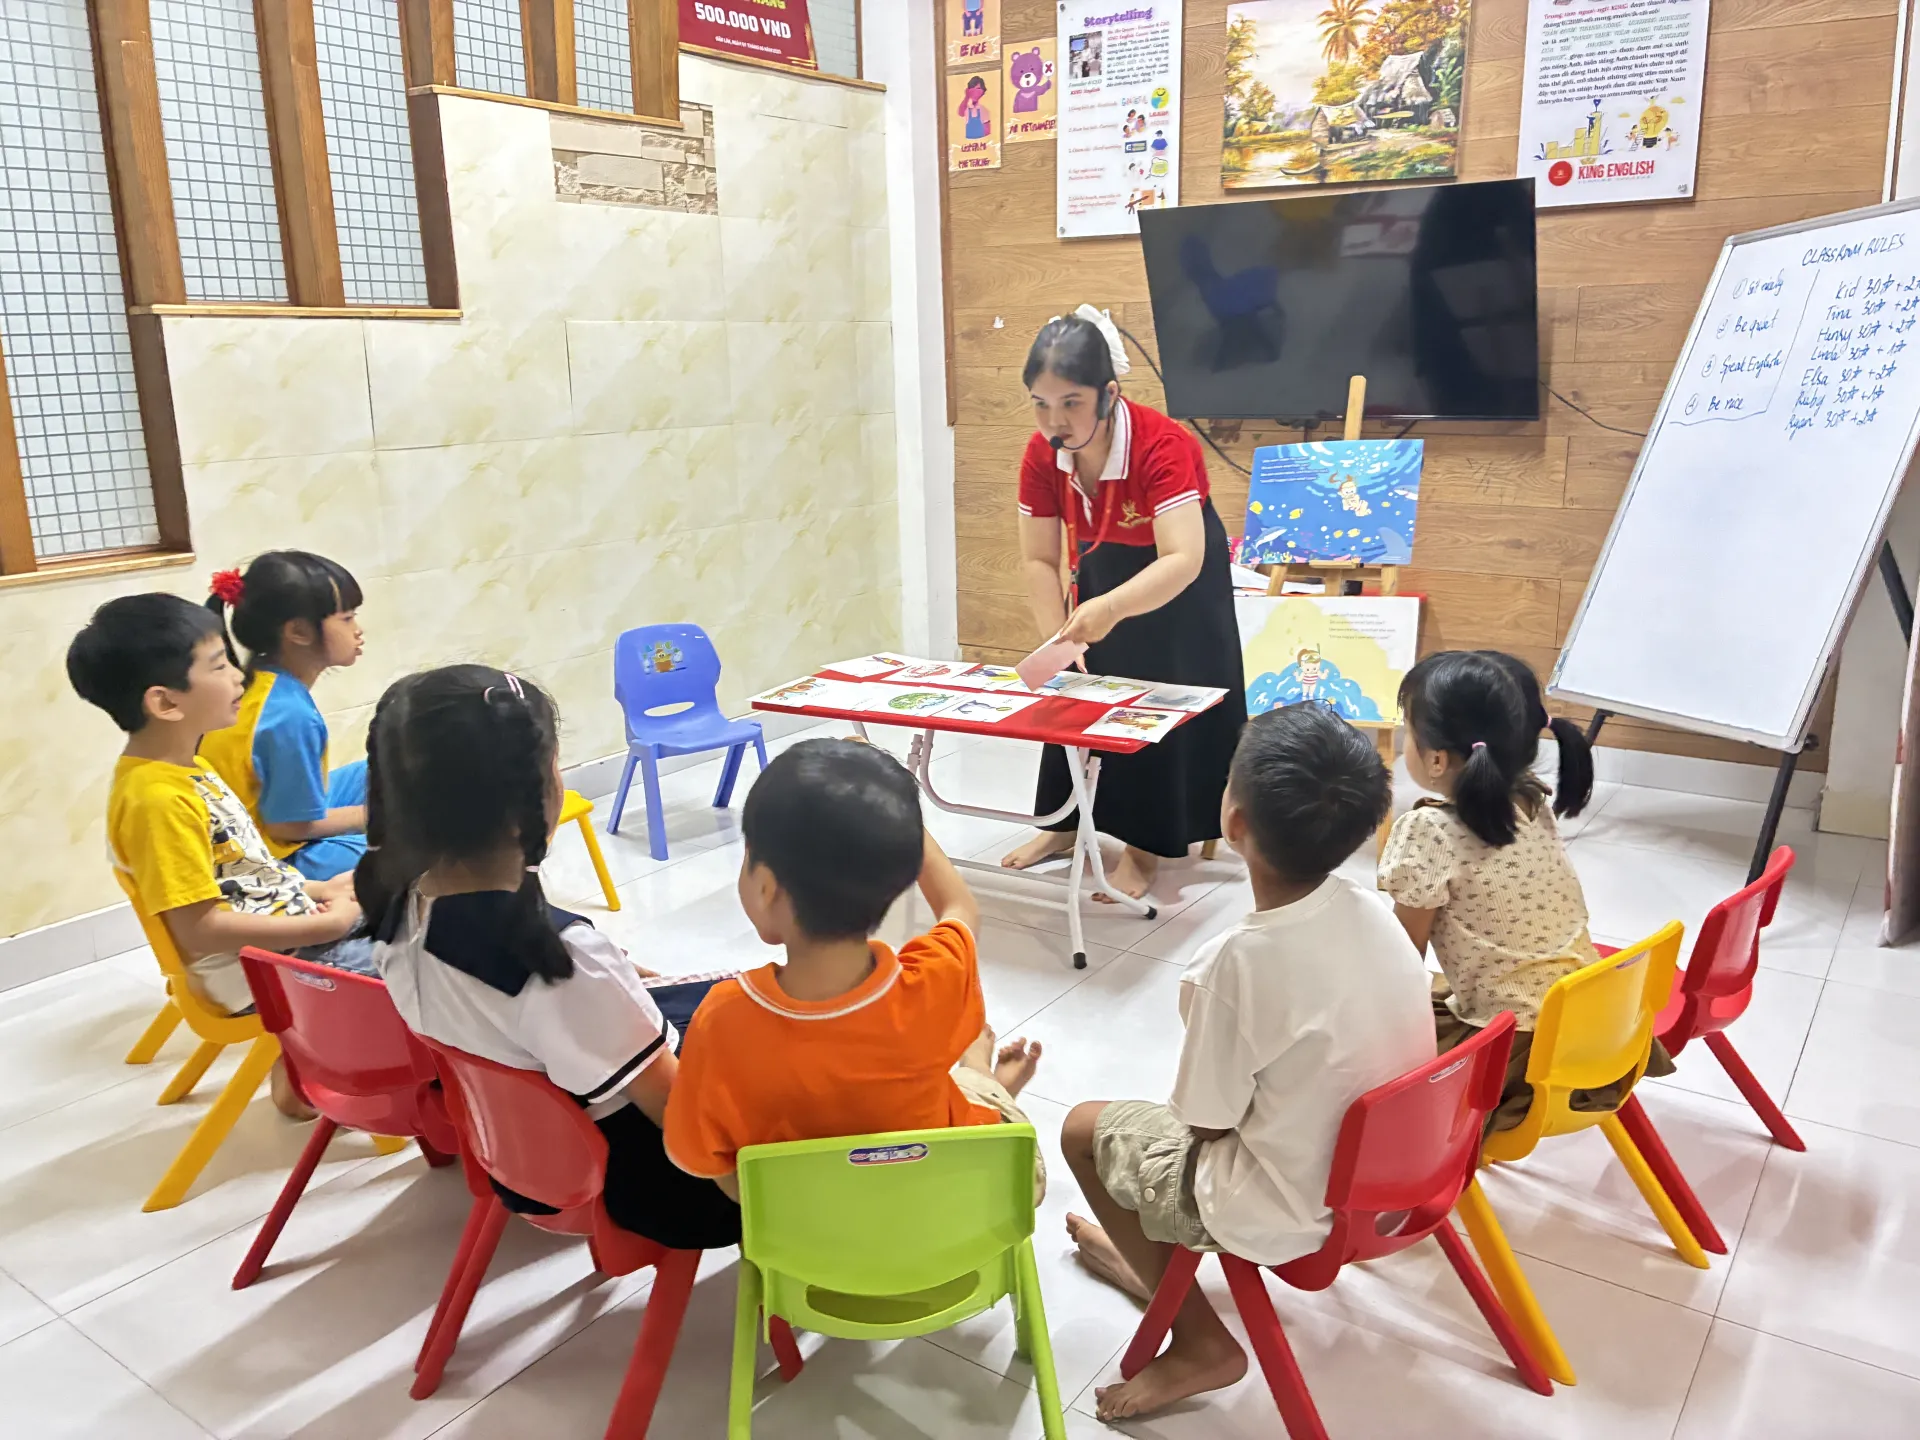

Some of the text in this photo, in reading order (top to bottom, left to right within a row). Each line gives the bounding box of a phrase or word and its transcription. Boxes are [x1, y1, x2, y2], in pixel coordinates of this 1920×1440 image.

[694, 2, 792, 39] 500.000 VND
[1084, 7, 1153, 27] Storytelling
[1578, 160, 1655, 180] KING ENGLISH
[1864, 233, 1905, 256] RULES
[1801, 365, 1829, 387] Elsa
